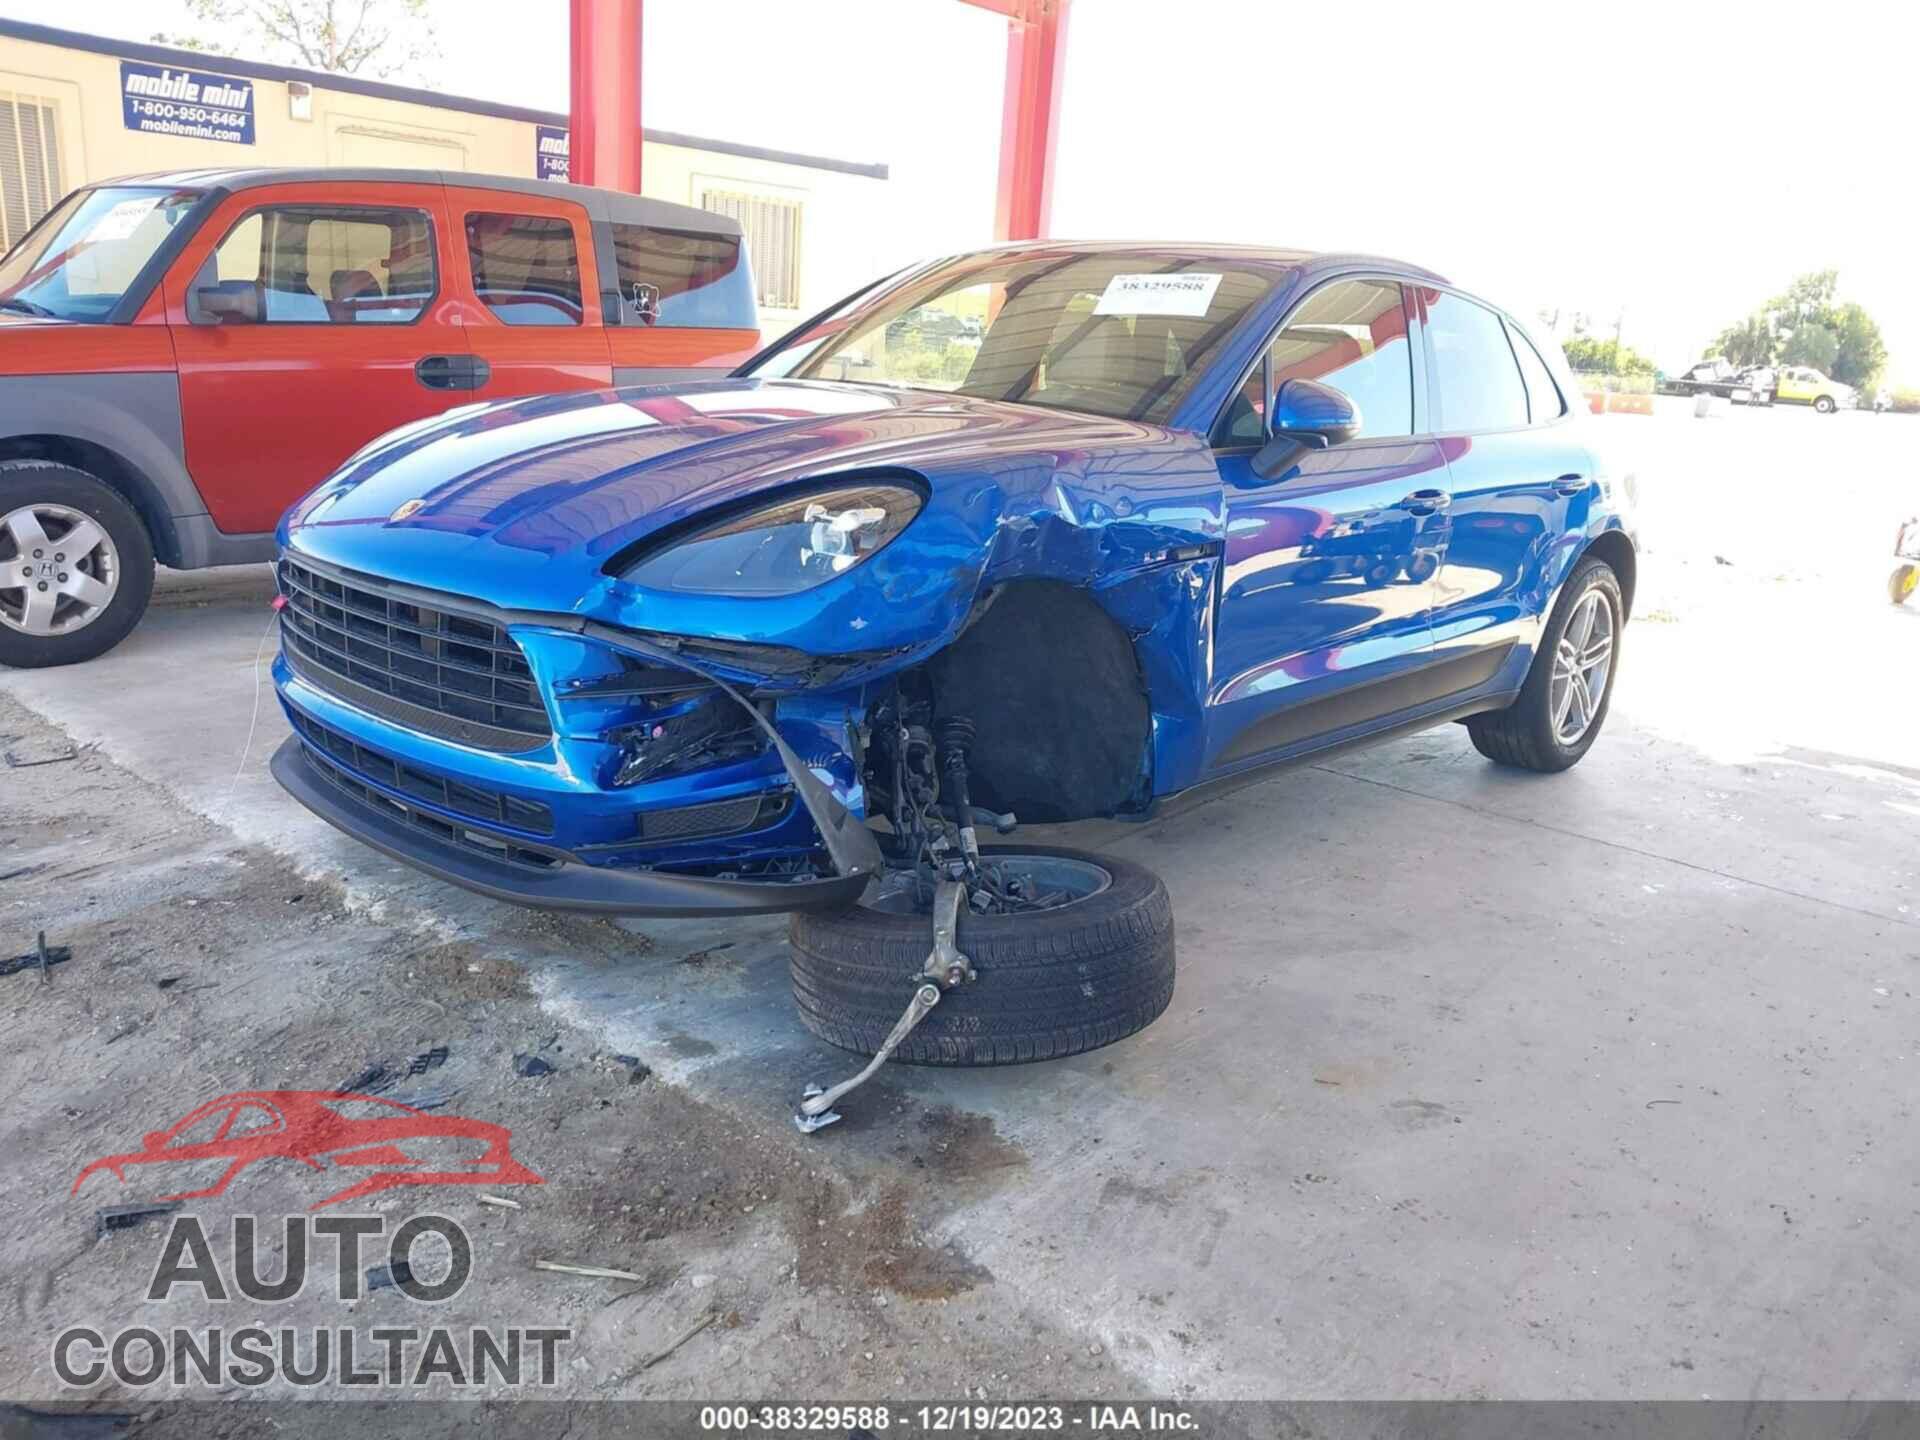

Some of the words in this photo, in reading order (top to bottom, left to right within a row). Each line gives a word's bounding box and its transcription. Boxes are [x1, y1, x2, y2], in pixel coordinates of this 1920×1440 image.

[126, 70, 200, 102] mobile
[201, 83, 252, 109] mini
[132, 100, 246, 128] 1-800-950-6464
[141, 119, 241, 142] mobilemini.com
